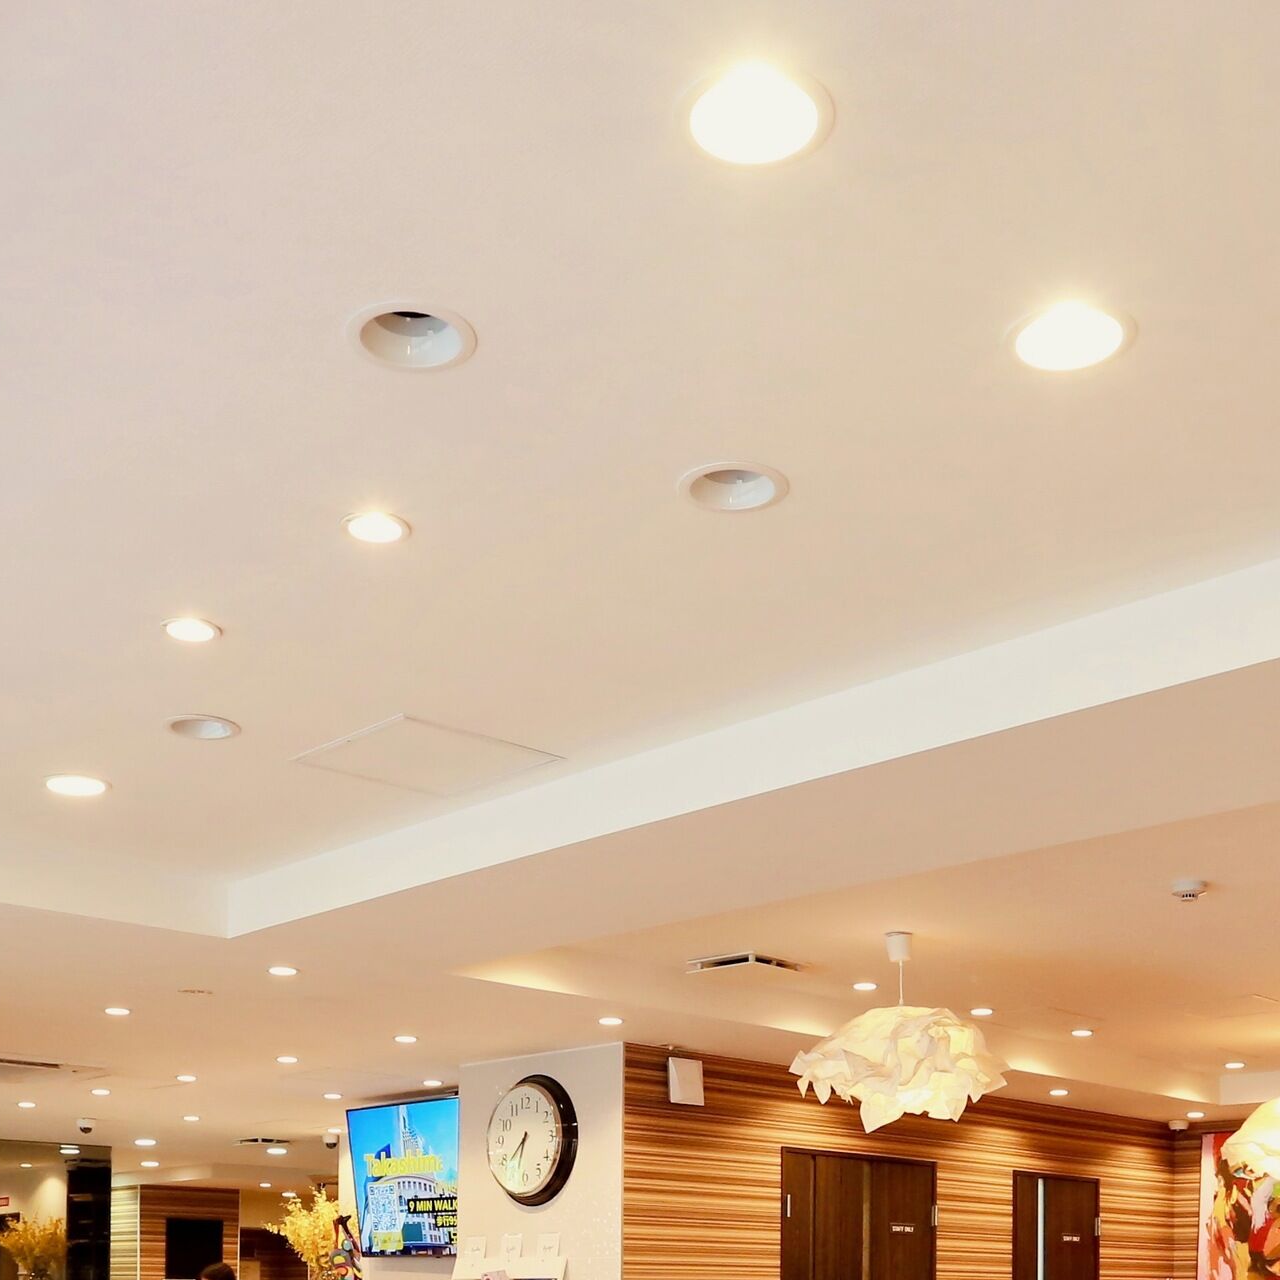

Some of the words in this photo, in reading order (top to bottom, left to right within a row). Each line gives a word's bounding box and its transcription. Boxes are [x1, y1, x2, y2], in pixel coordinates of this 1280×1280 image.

[408, 1201, 415, 1212] 9
[416, 1199, 433, 1212] MIN
[434, 1197, 457, 1211] WALK
